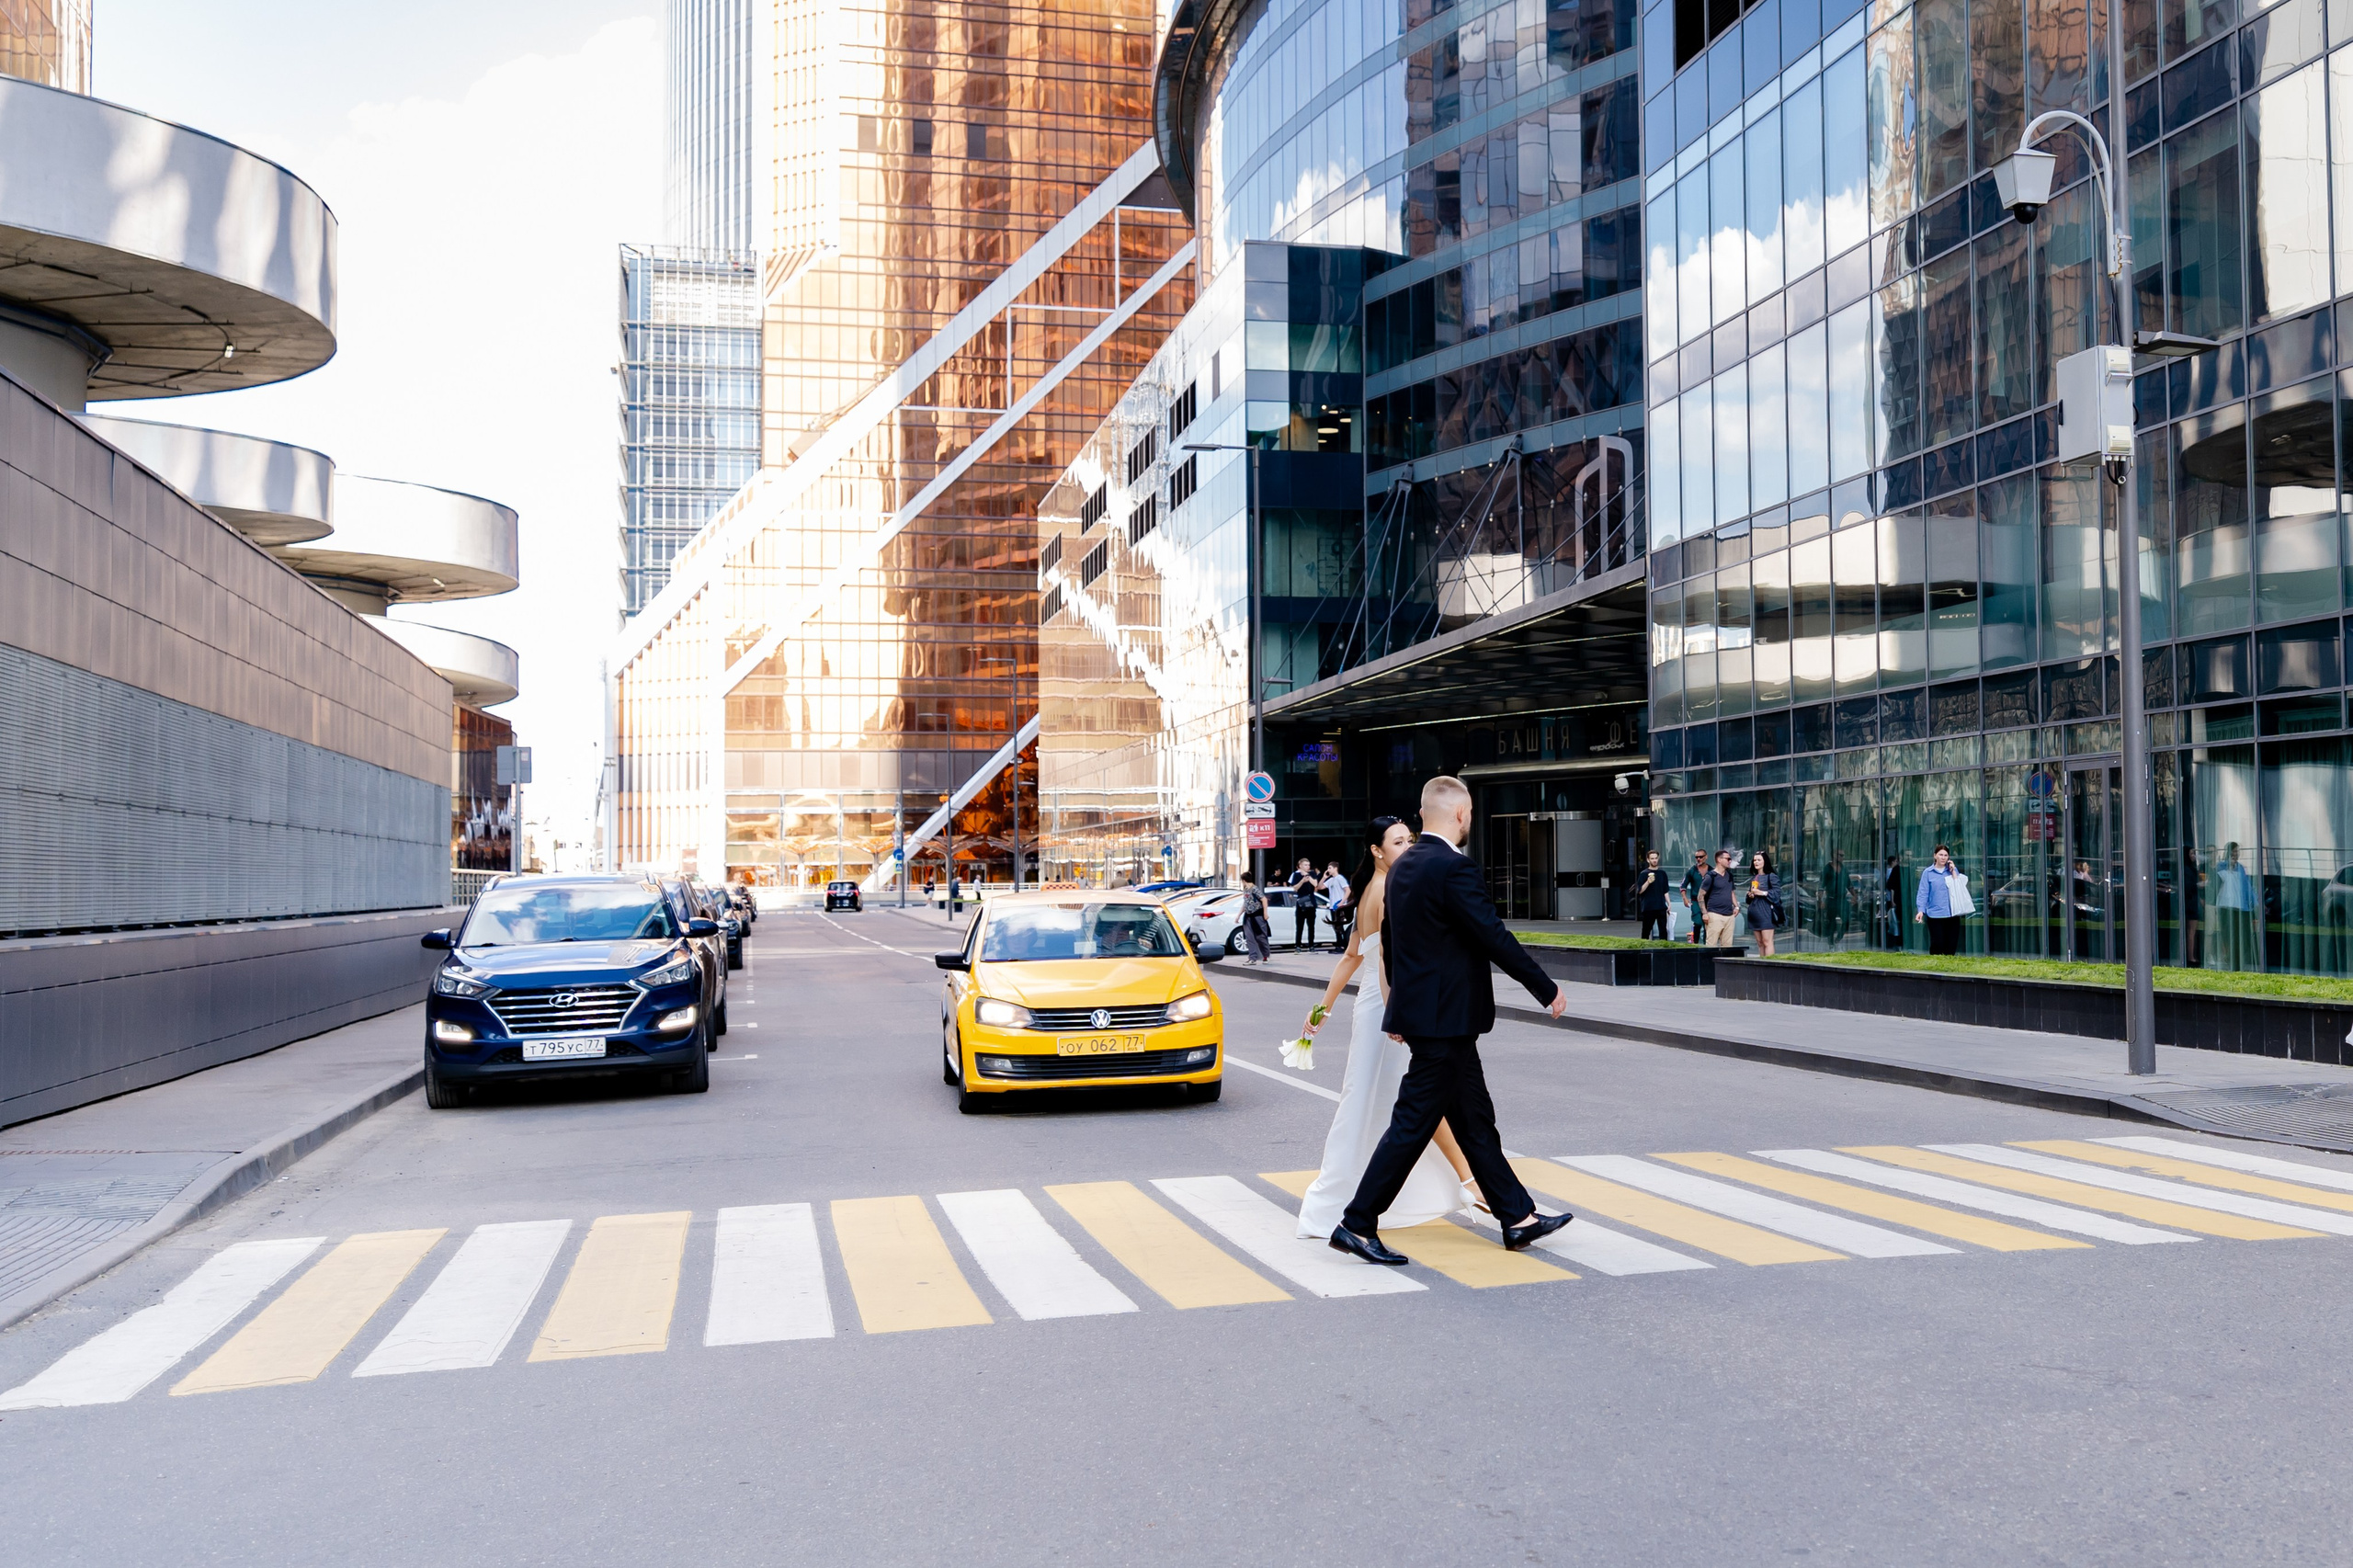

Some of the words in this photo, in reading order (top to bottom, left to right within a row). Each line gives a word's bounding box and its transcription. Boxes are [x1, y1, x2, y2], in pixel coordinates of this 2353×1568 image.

[1498, 724, 1570, 755] БАШНЯ
[1302, 744, 1333, 753] САЛОН
[1297, 753, 1338, 762] КРАСОТЫ
[587, 1039, 600, 1049] 77
[1091, 1039, 1117, 1052] 062
[1126, 1037, 1139, 1047] 77
